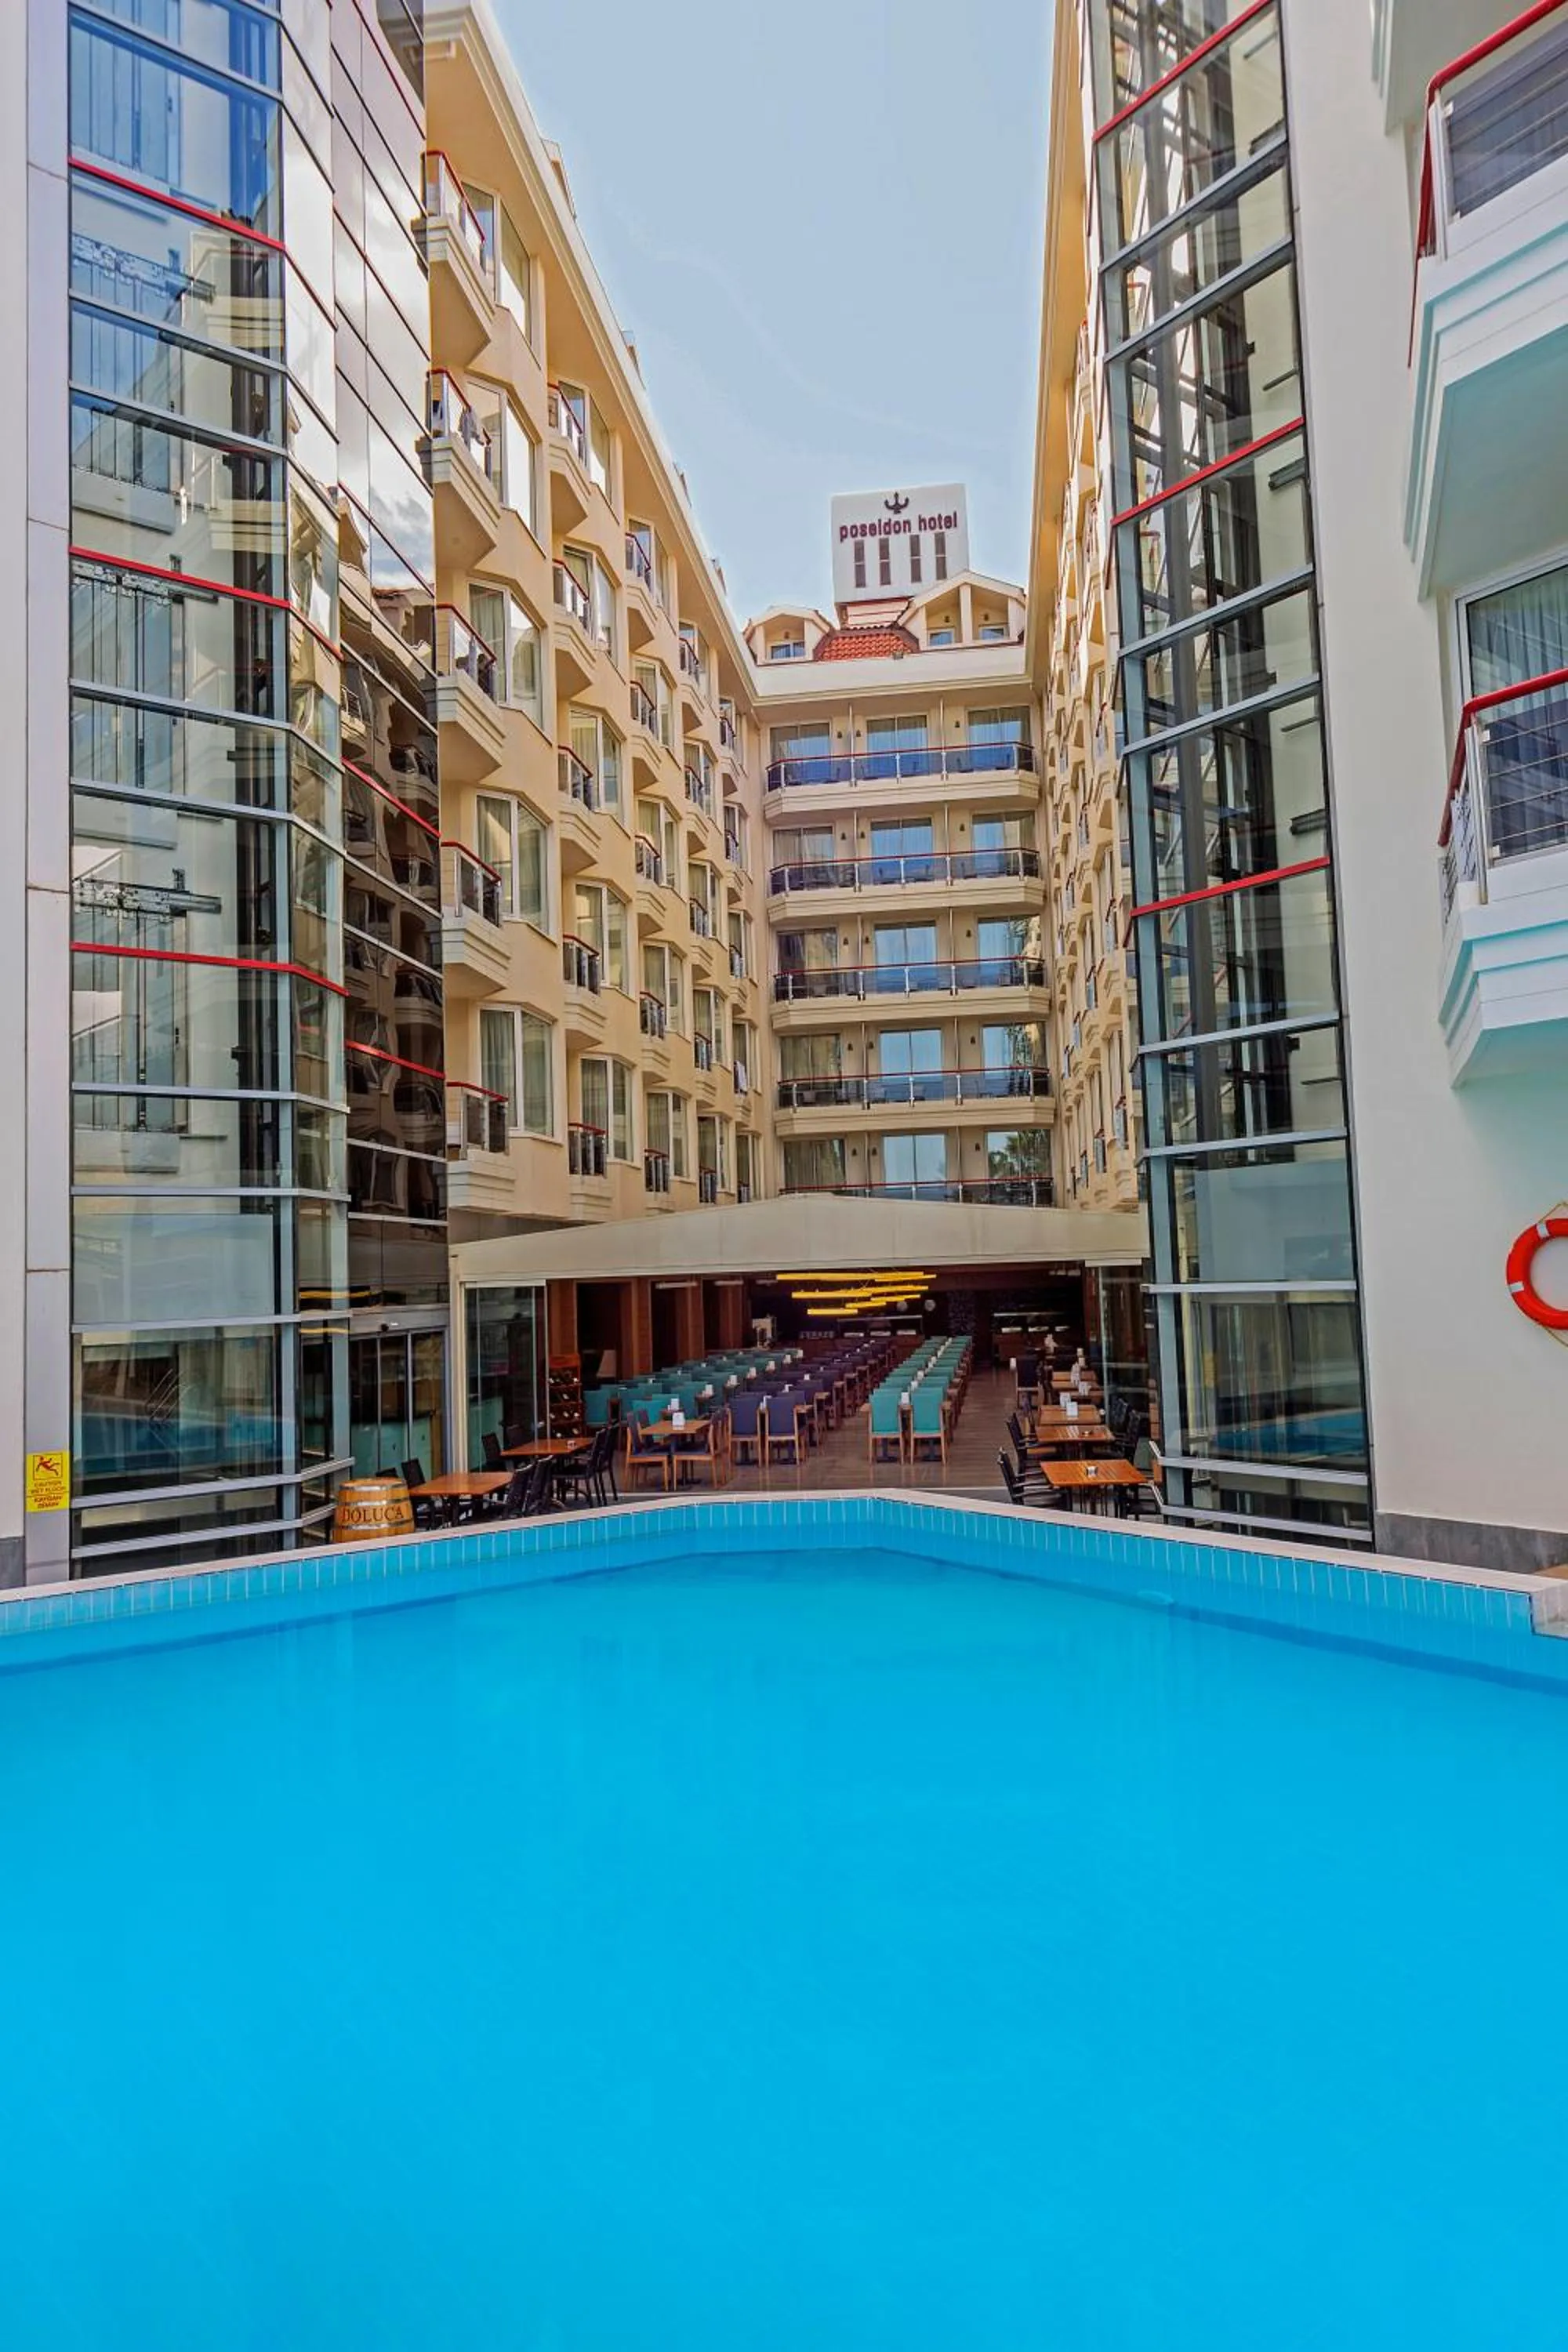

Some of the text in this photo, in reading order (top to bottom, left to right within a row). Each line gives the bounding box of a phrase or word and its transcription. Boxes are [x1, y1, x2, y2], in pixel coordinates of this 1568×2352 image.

[840, 510, 957, 543] poseidon hotel
[341, 1505, 404, 1523] DOLUCA
